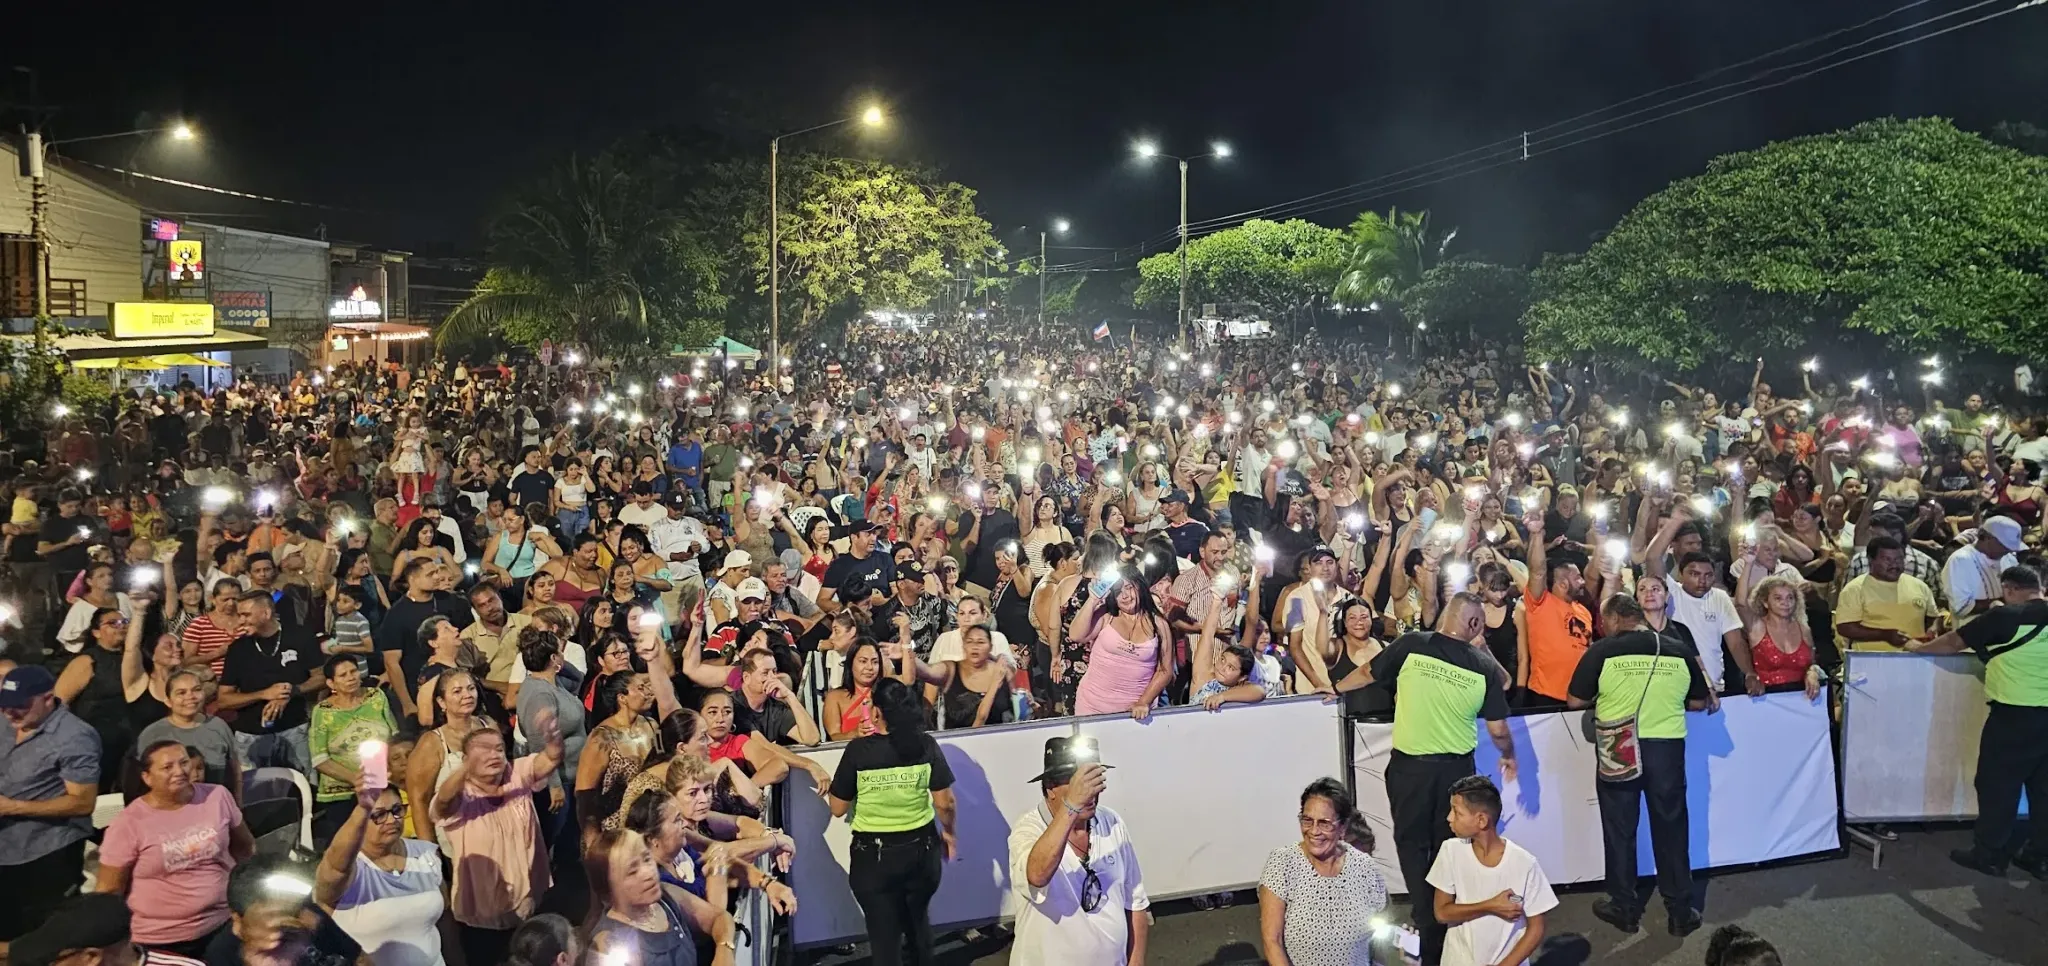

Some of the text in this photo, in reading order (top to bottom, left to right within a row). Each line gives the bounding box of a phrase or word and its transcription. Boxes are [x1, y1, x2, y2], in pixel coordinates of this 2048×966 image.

[1613, 661, 1650, 669] SECURITY
[1413, 660, 1477, 685] SECURITY GROUP
[861, 774, 898, 783] SECURITY
